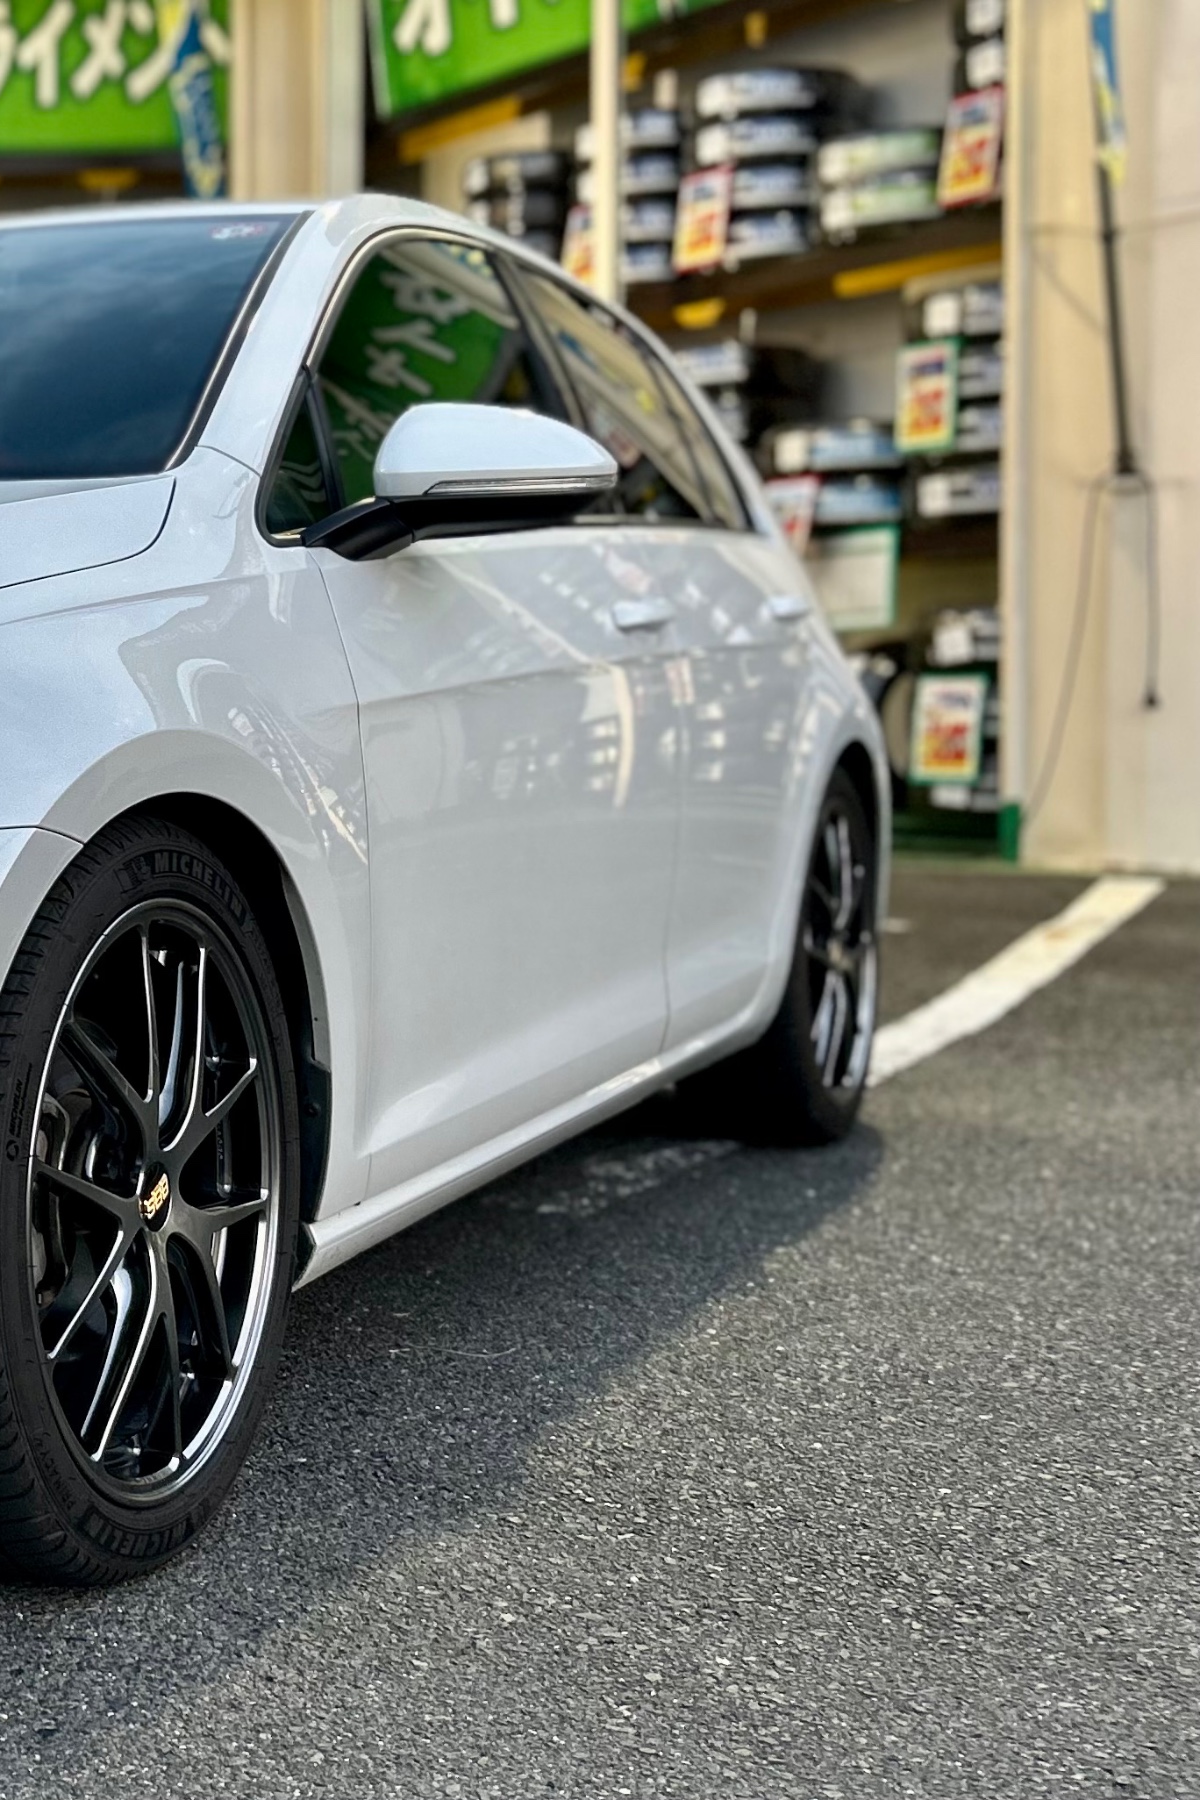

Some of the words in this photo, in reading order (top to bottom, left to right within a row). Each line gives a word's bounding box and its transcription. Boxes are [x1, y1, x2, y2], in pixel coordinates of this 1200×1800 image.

[154, 851, 243, 918] MICHELIN
[143, 1172, 169, 1220] BBS
[84, 1512, 189, 1557] MICHELIN
